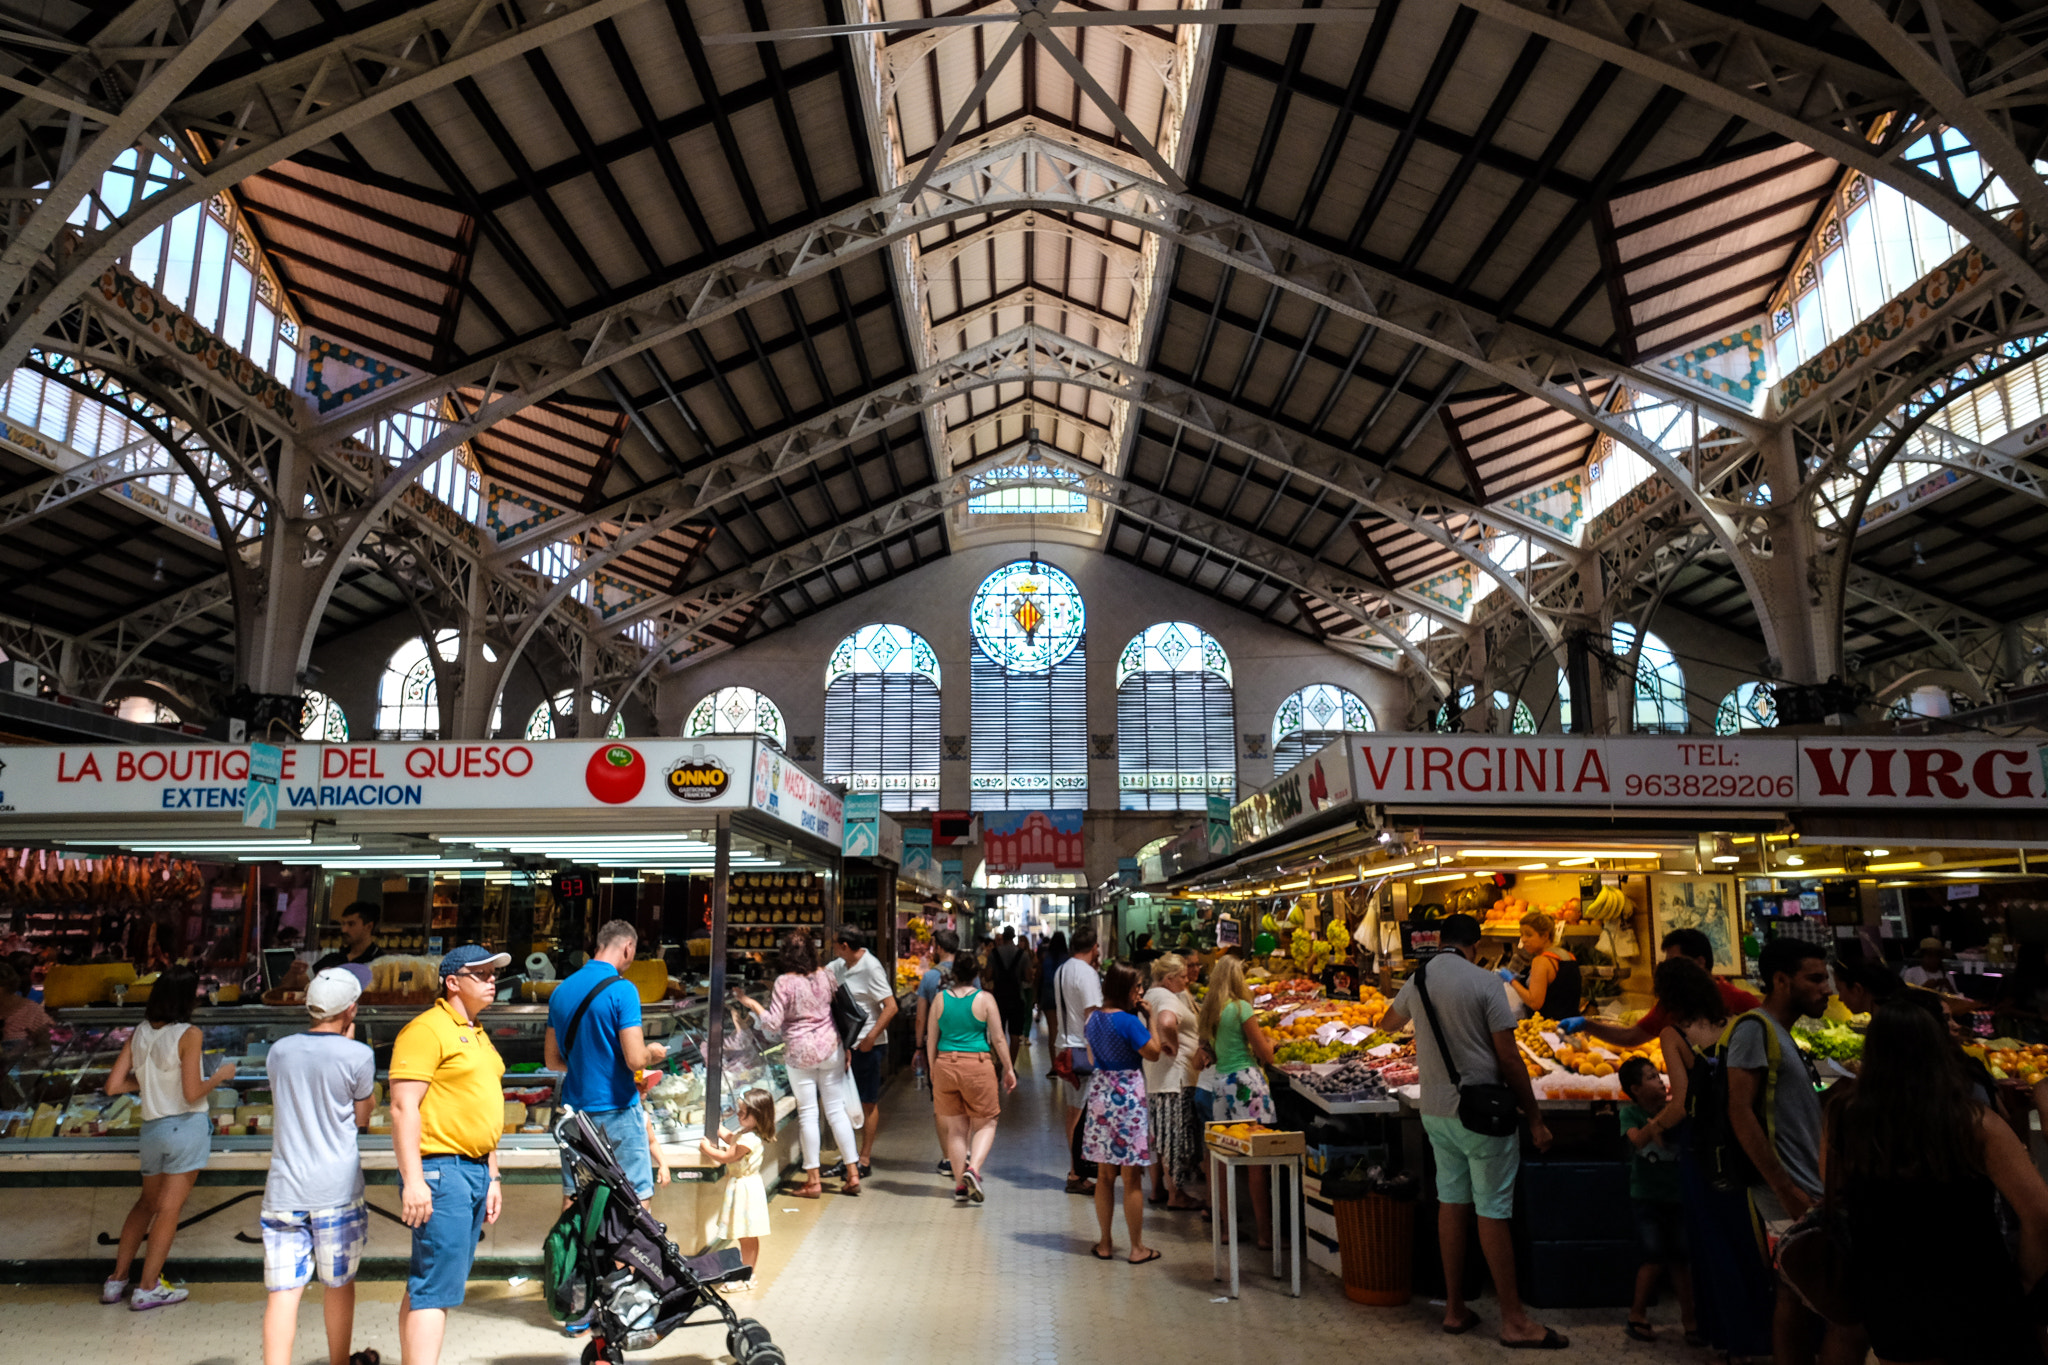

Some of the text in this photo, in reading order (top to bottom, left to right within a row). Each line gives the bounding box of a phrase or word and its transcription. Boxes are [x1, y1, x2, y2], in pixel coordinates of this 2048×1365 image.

[57, 751, 103, 783] LA
[116, 749, 297, 782] BOUTIQE
[322, 747, 385, 779] DEL
[405, 745, 534, 780] QUESO
[1677, 743, 1741, 767] TEL:
[671, 769, 725, 786] ONNO
[1361, 745, 1612, 794] VIRGINIA
[1804, 747, 2047, 799] VIRG
[162, 784, 422, 809] EXTENS VARIACION
[1624, 773, 1794, 798] 963829206
[561, 879, 584, 897] 93
